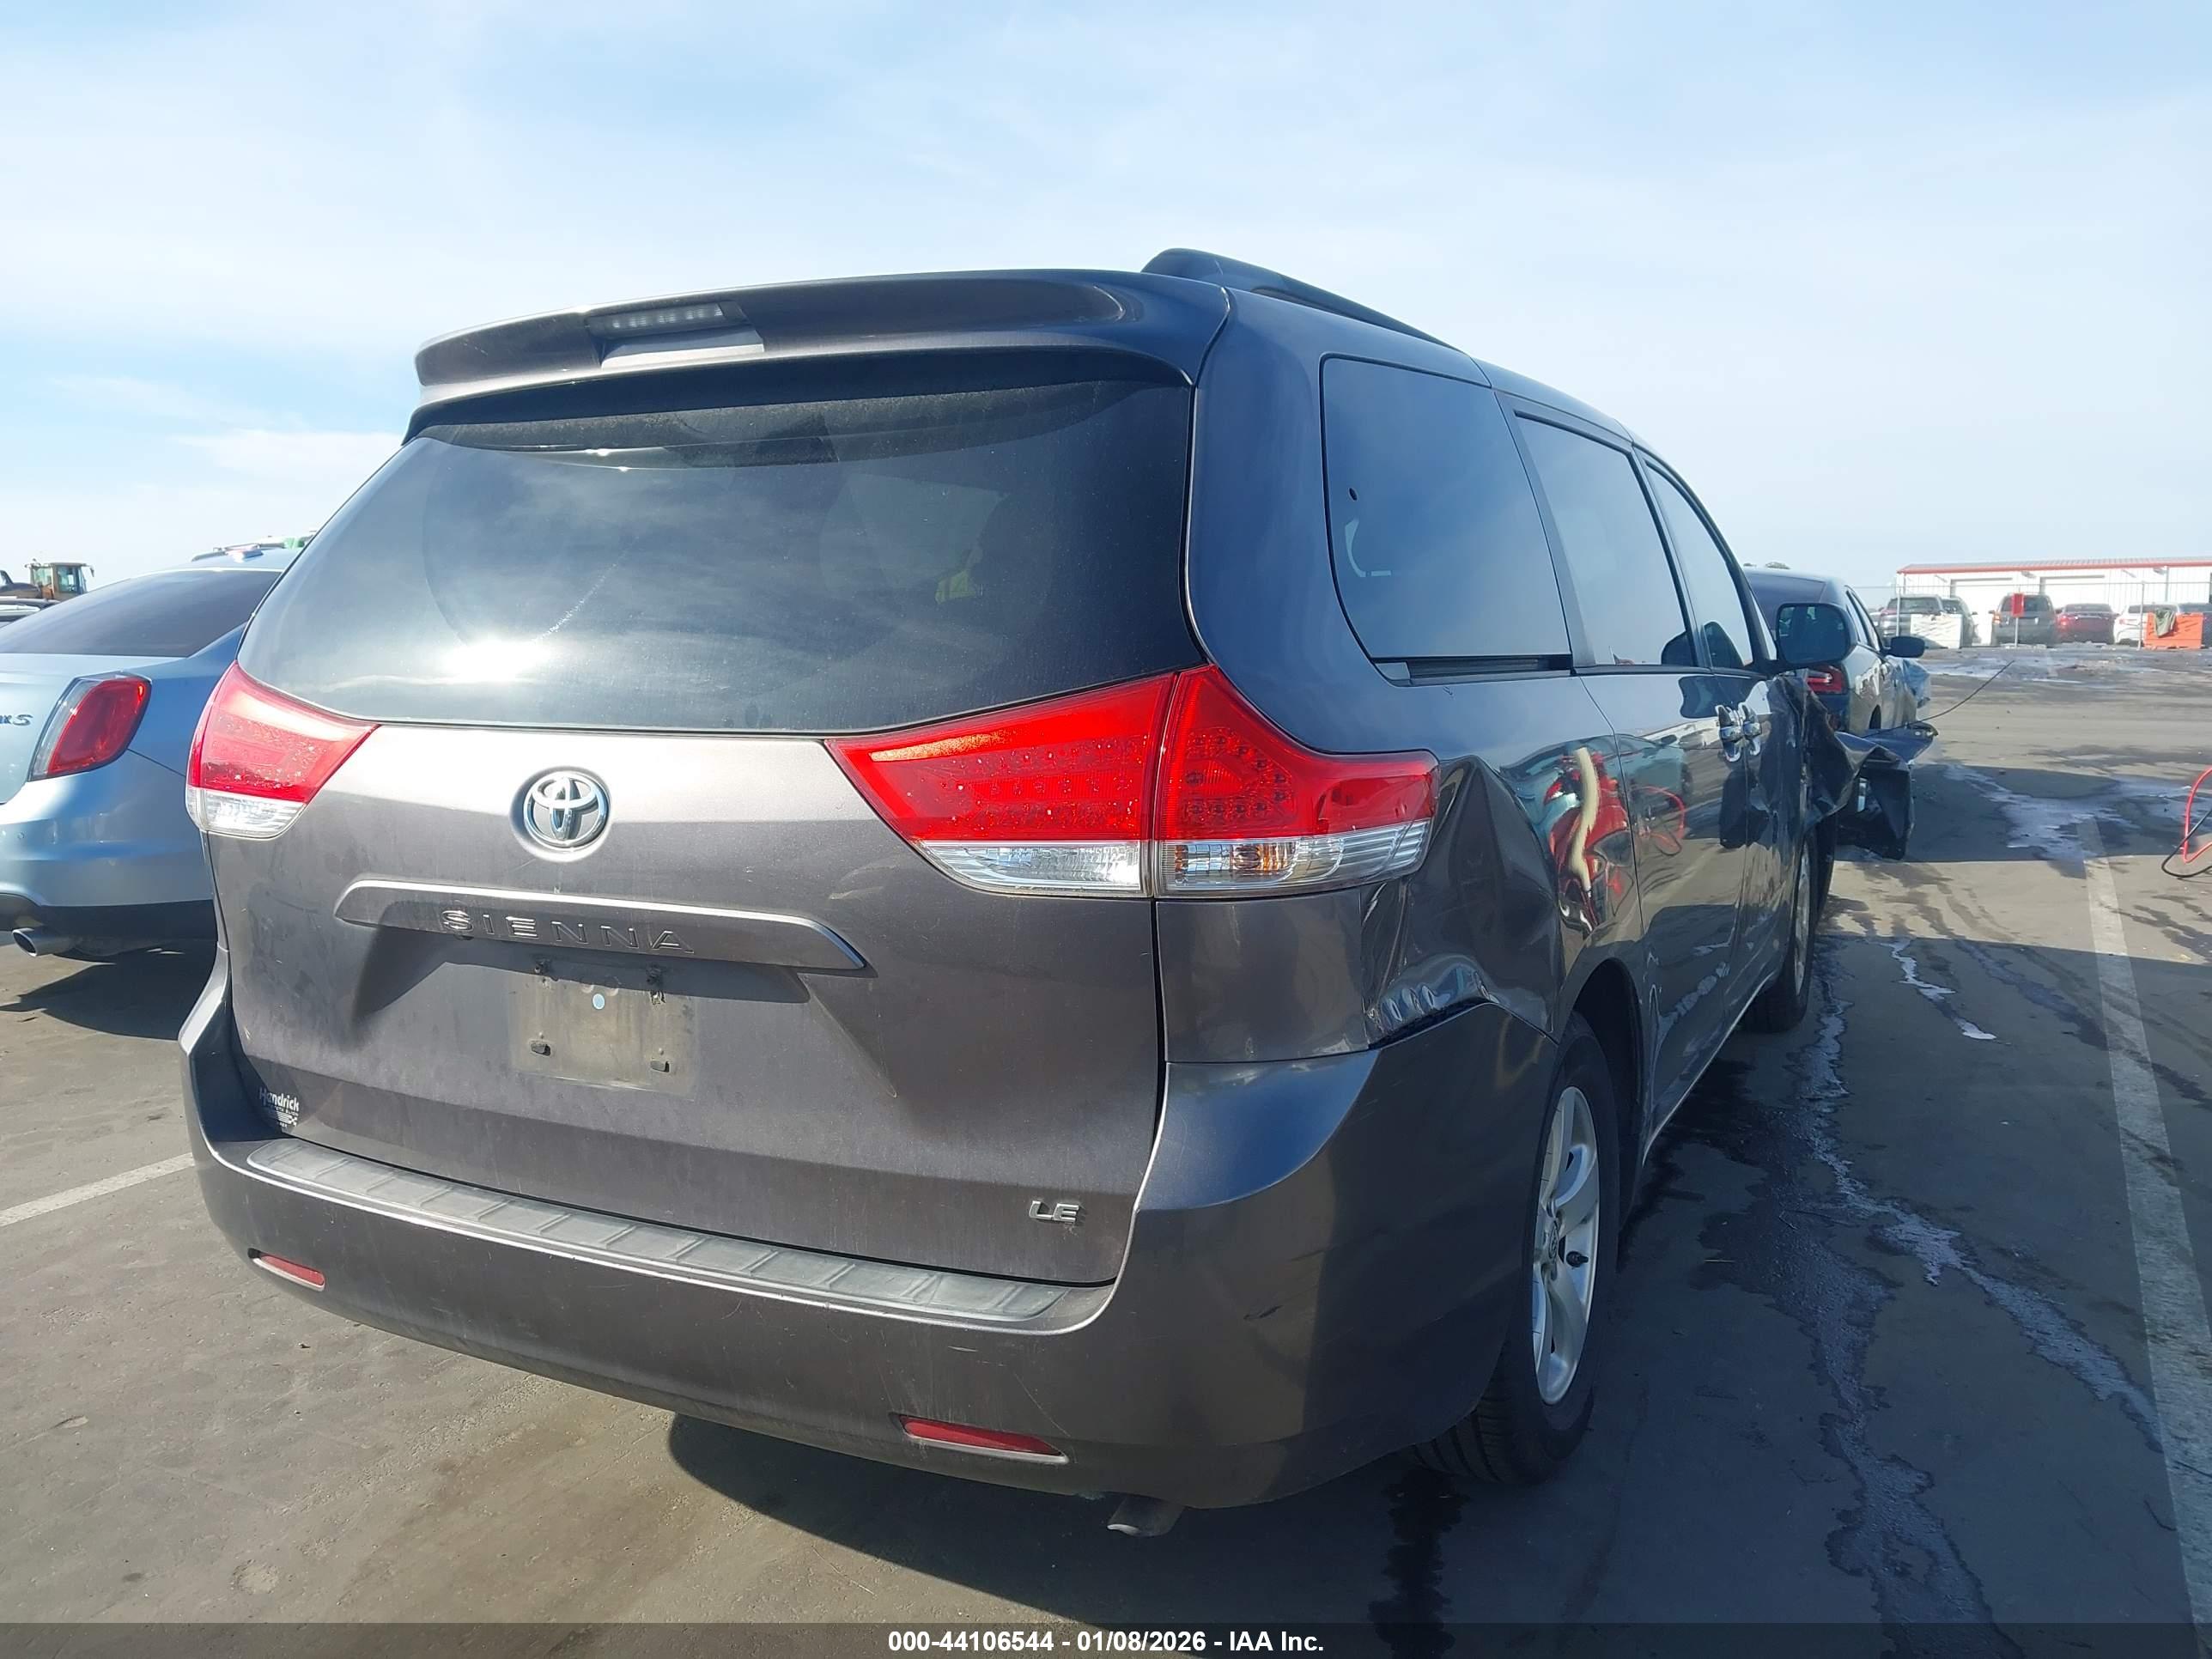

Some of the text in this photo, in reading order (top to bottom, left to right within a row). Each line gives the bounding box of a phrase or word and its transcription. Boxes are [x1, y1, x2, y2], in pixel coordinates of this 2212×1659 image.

[440, 909, 695, 954] SIENNA
[259, 1087, 300, 1112] Hendrick
[1029, 1200, 1079, 1223] LE
